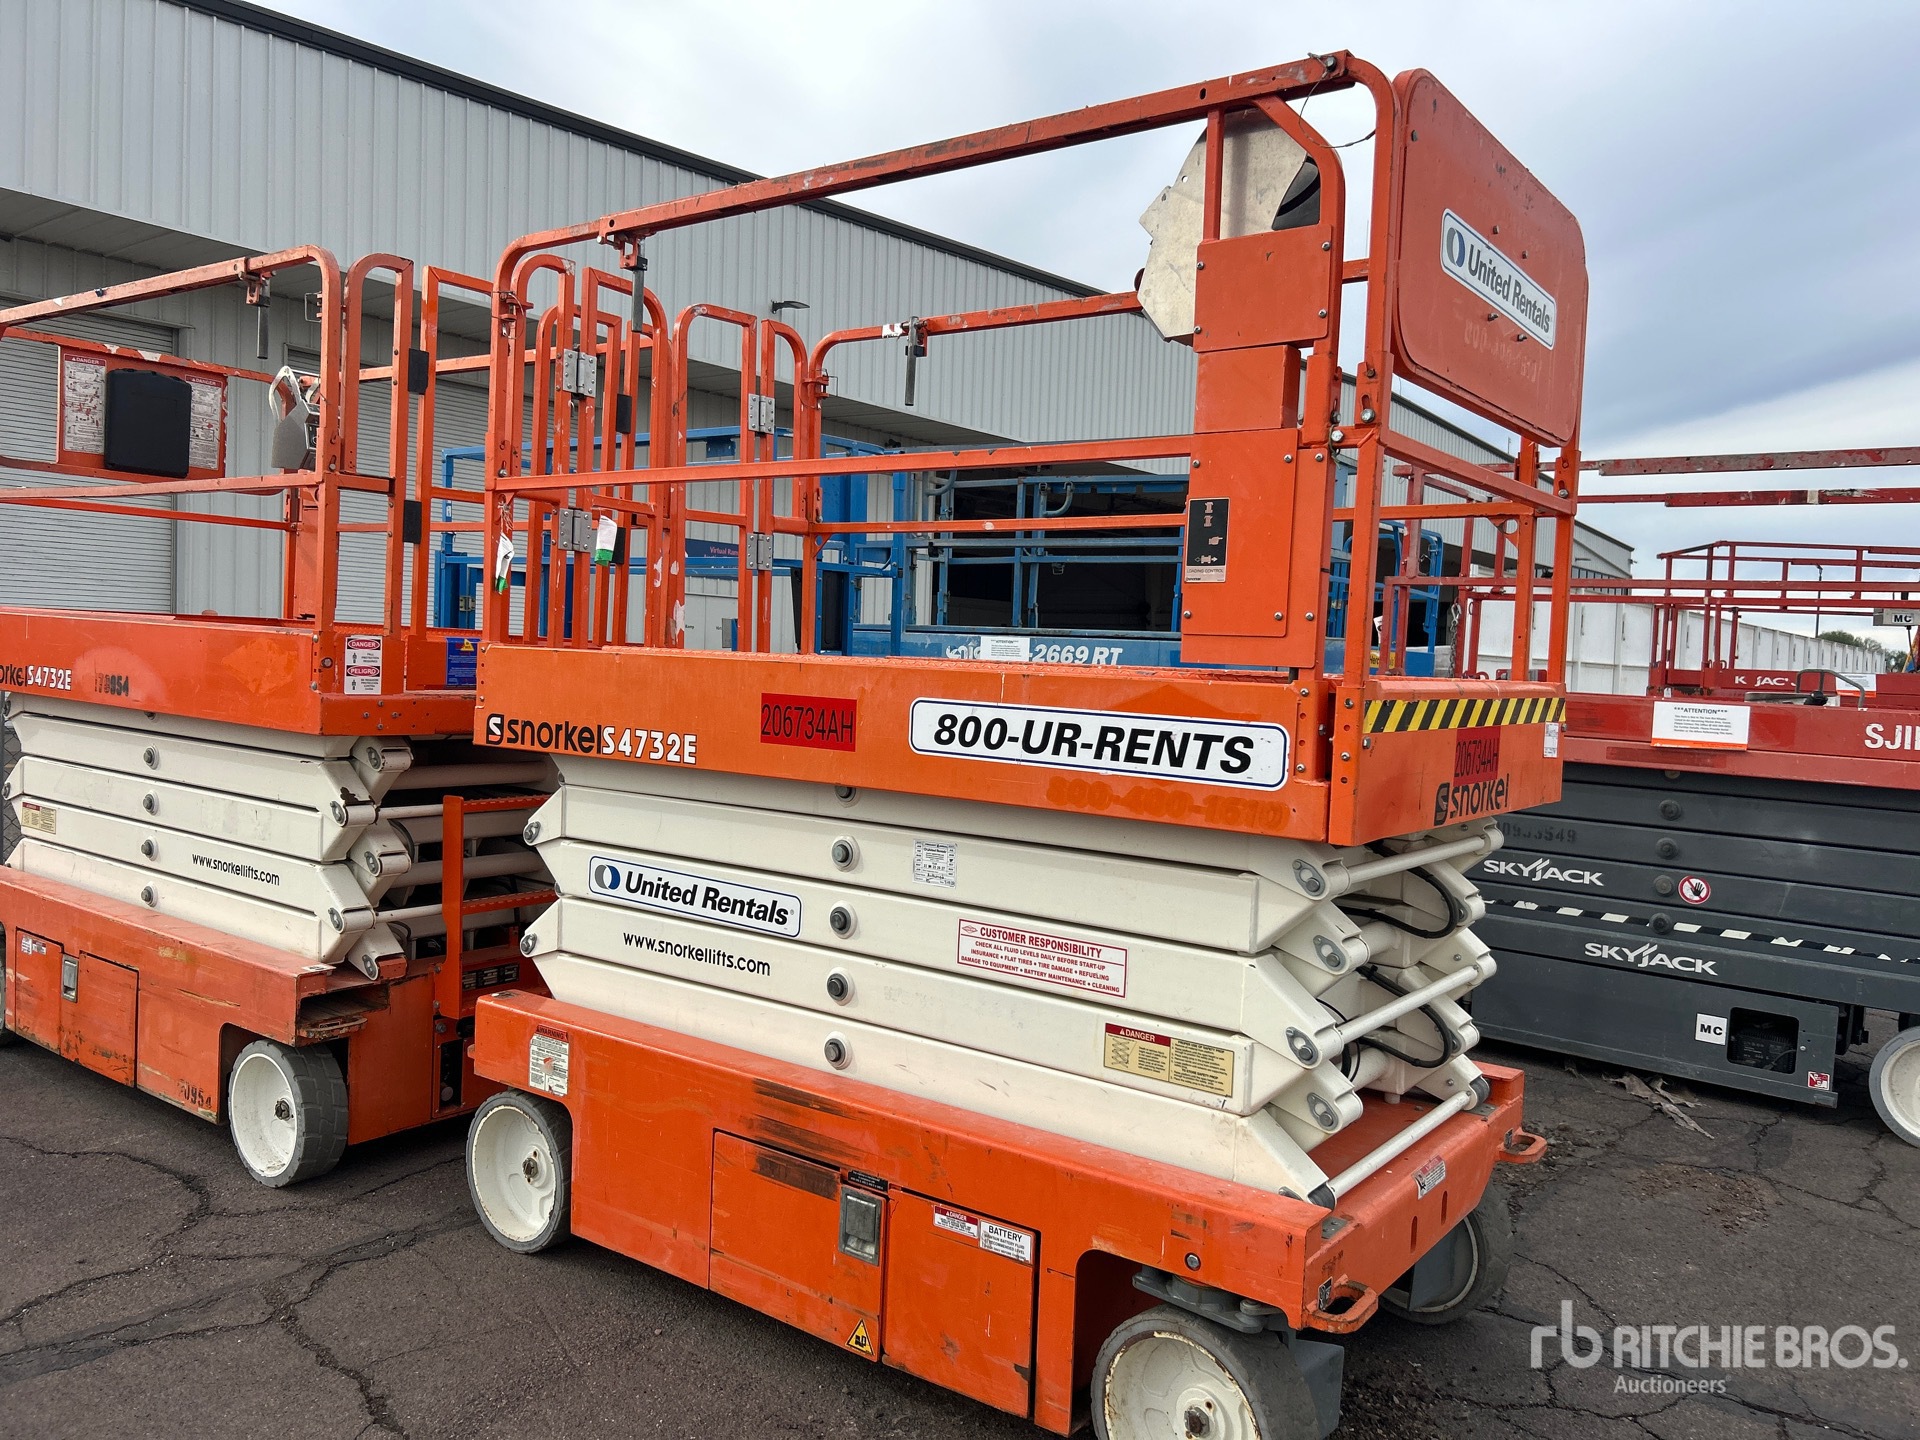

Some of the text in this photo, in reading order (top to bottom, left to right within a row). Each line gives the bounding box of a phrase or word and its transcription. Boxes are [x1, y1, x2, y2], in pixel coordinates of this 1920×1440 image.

[1467, 244, 1551, 334] United Rentals
[710, 546, 727, 555] Virtual
[1894, 615, 1912, 623] MC
[1092, 645, 1124, 665] RT
[26, 664, 73, 691] S4732E
[761, 703, 854, 744] 206734AH
[506, 719, 697, 765] snorkel S4732E
[933, 713, 1255, 774] 800-UR-RENTS
[1454, 738, 1498, 778] 206734AH
[1450, 773, 1509, 819] snorkel
[192, 854, 280, 886] www.snorkellifts.com
[1483, 857, 1604, 887] SKYJACK
[625, 871, 789, 926] United Rentals
[623, 932, 771, 976] www.snorkellifts.com
[975, 940, 993, 950] CHECK
[1003, 945, 1019, 954] FLUID
[1020, 948, 1039, 958] LEVELS
[1040, 952, 1056, 961] DAILY
[1057, 956, 1077, 966] BEFORE
[1079, 960, 1106, 971] START-UP
[980, 927, 1026, 944] CUSTOMER
[1028, 935, 1102, 958] RESPONSIBILITY
[961, 955, 981, 965] DAMAGE
[990, 961, 1018, 972] EQUIPMENT
[1024, 968, 1047, 978] BATTERY
[1048, 973, 1086, 986] MAINTENANCE
[1091, 982, 1119, 993] CLEANING
[971, 948, 1110, 981] INSURANCE FLAT TIRES TIRE DAMAGE REFUELING
[1584, 942, 1718, 976] SKYJACK
[1125, 1029, 1156, 1042] DANGER
[1699, 1023, 1723, 1036] MC
[949, 1211, 967, 1221] DANGER
[988, 1225, 1023, 1242] BATTERY
